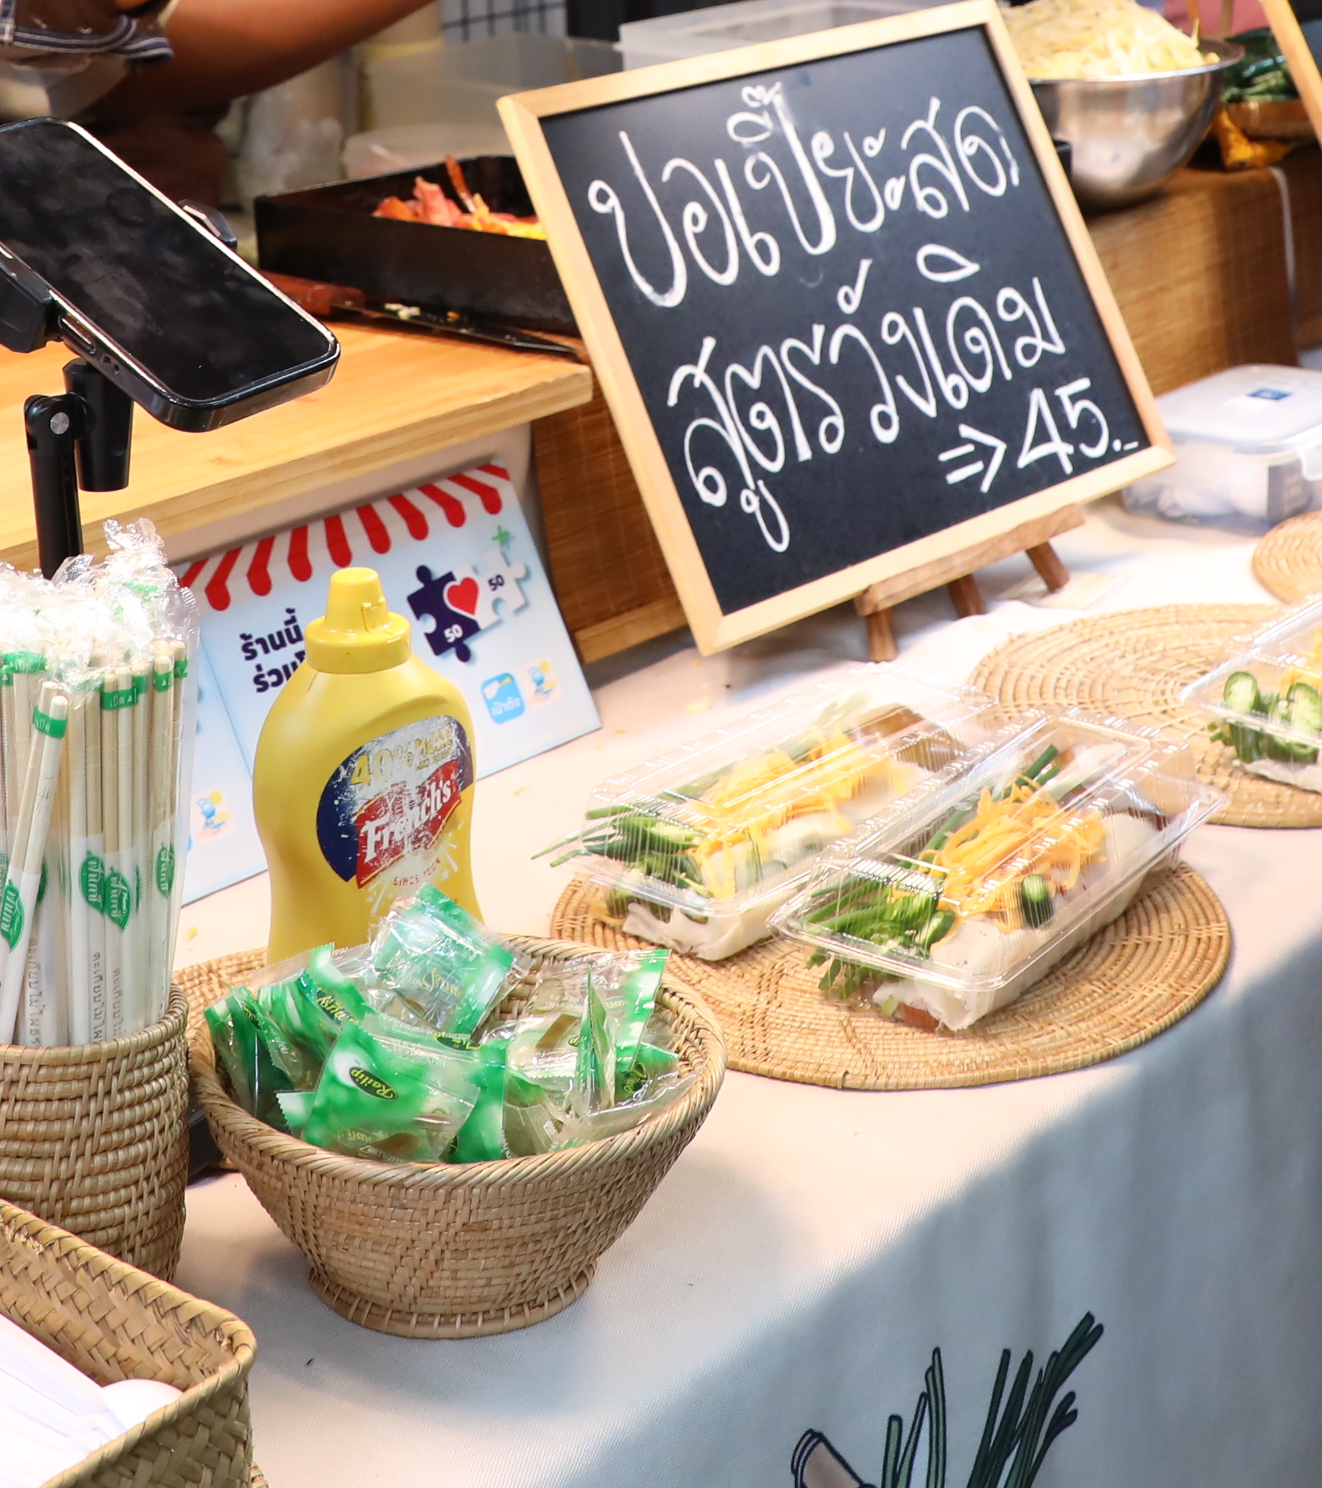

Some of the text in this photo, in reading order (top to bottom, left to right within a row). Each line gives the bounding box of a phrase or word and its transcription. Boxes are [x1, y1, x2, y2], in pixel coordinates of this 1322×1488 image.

[487, 574, 505, 592] 50
[239, 607, 305, 662] ร้านนี้
[443, 623, 464, 644] 50
